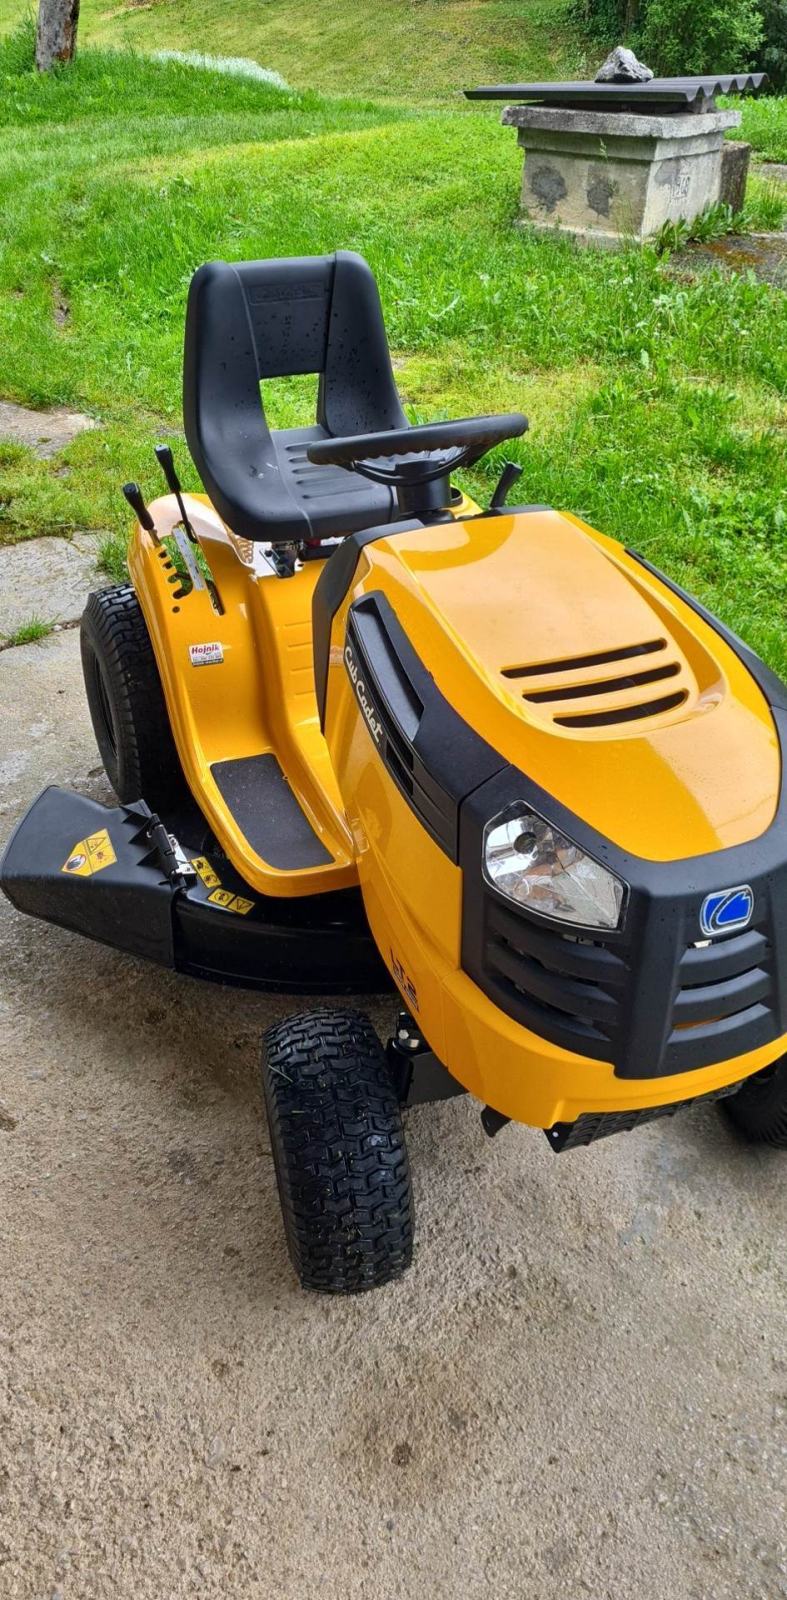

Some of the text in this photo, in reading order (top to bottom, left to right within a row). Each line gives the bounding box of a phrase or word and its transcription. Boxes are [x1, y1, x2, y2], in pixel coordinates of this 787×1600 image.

[191, 643, 220, 655] Hojnik
[344, 646, 383, 743] Cub Cadet
